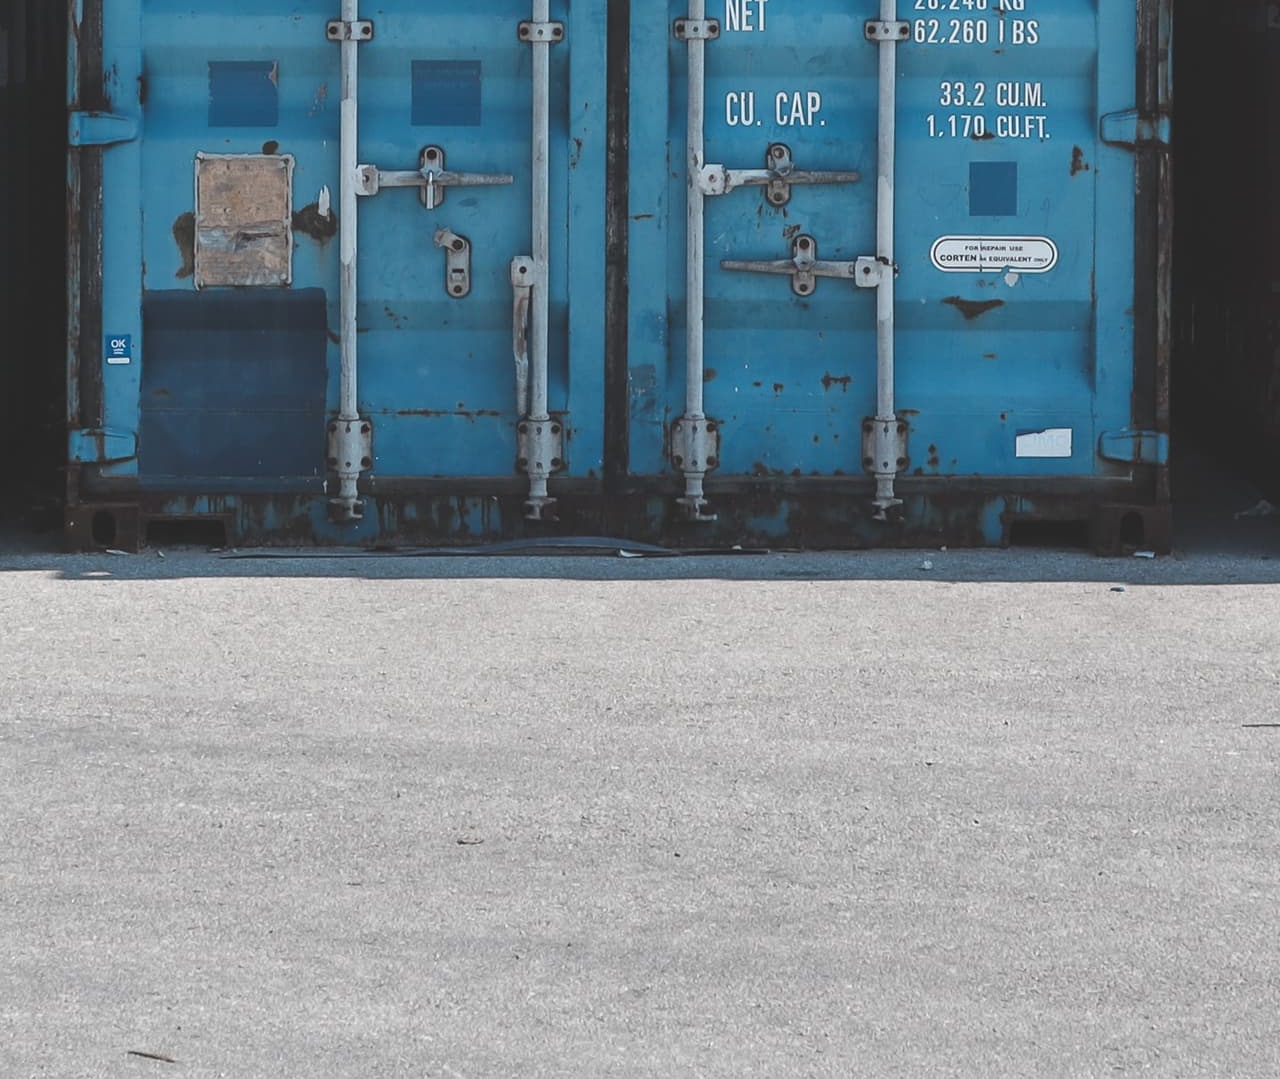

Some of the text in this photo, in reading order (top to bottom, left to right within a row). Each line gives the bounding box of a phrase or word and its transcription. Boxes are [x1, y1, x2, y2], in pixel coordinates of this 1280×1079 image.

[725, 81, 1047, 127] CU. CAP. 33.2 CU.M.
[996, 115, 1051, 138] CU.FT.
[939, 254, 977, 262] CORTEN
[988, 255, 1032, 263] EQUIVALENT
[110, 338, 127, 349] OK
